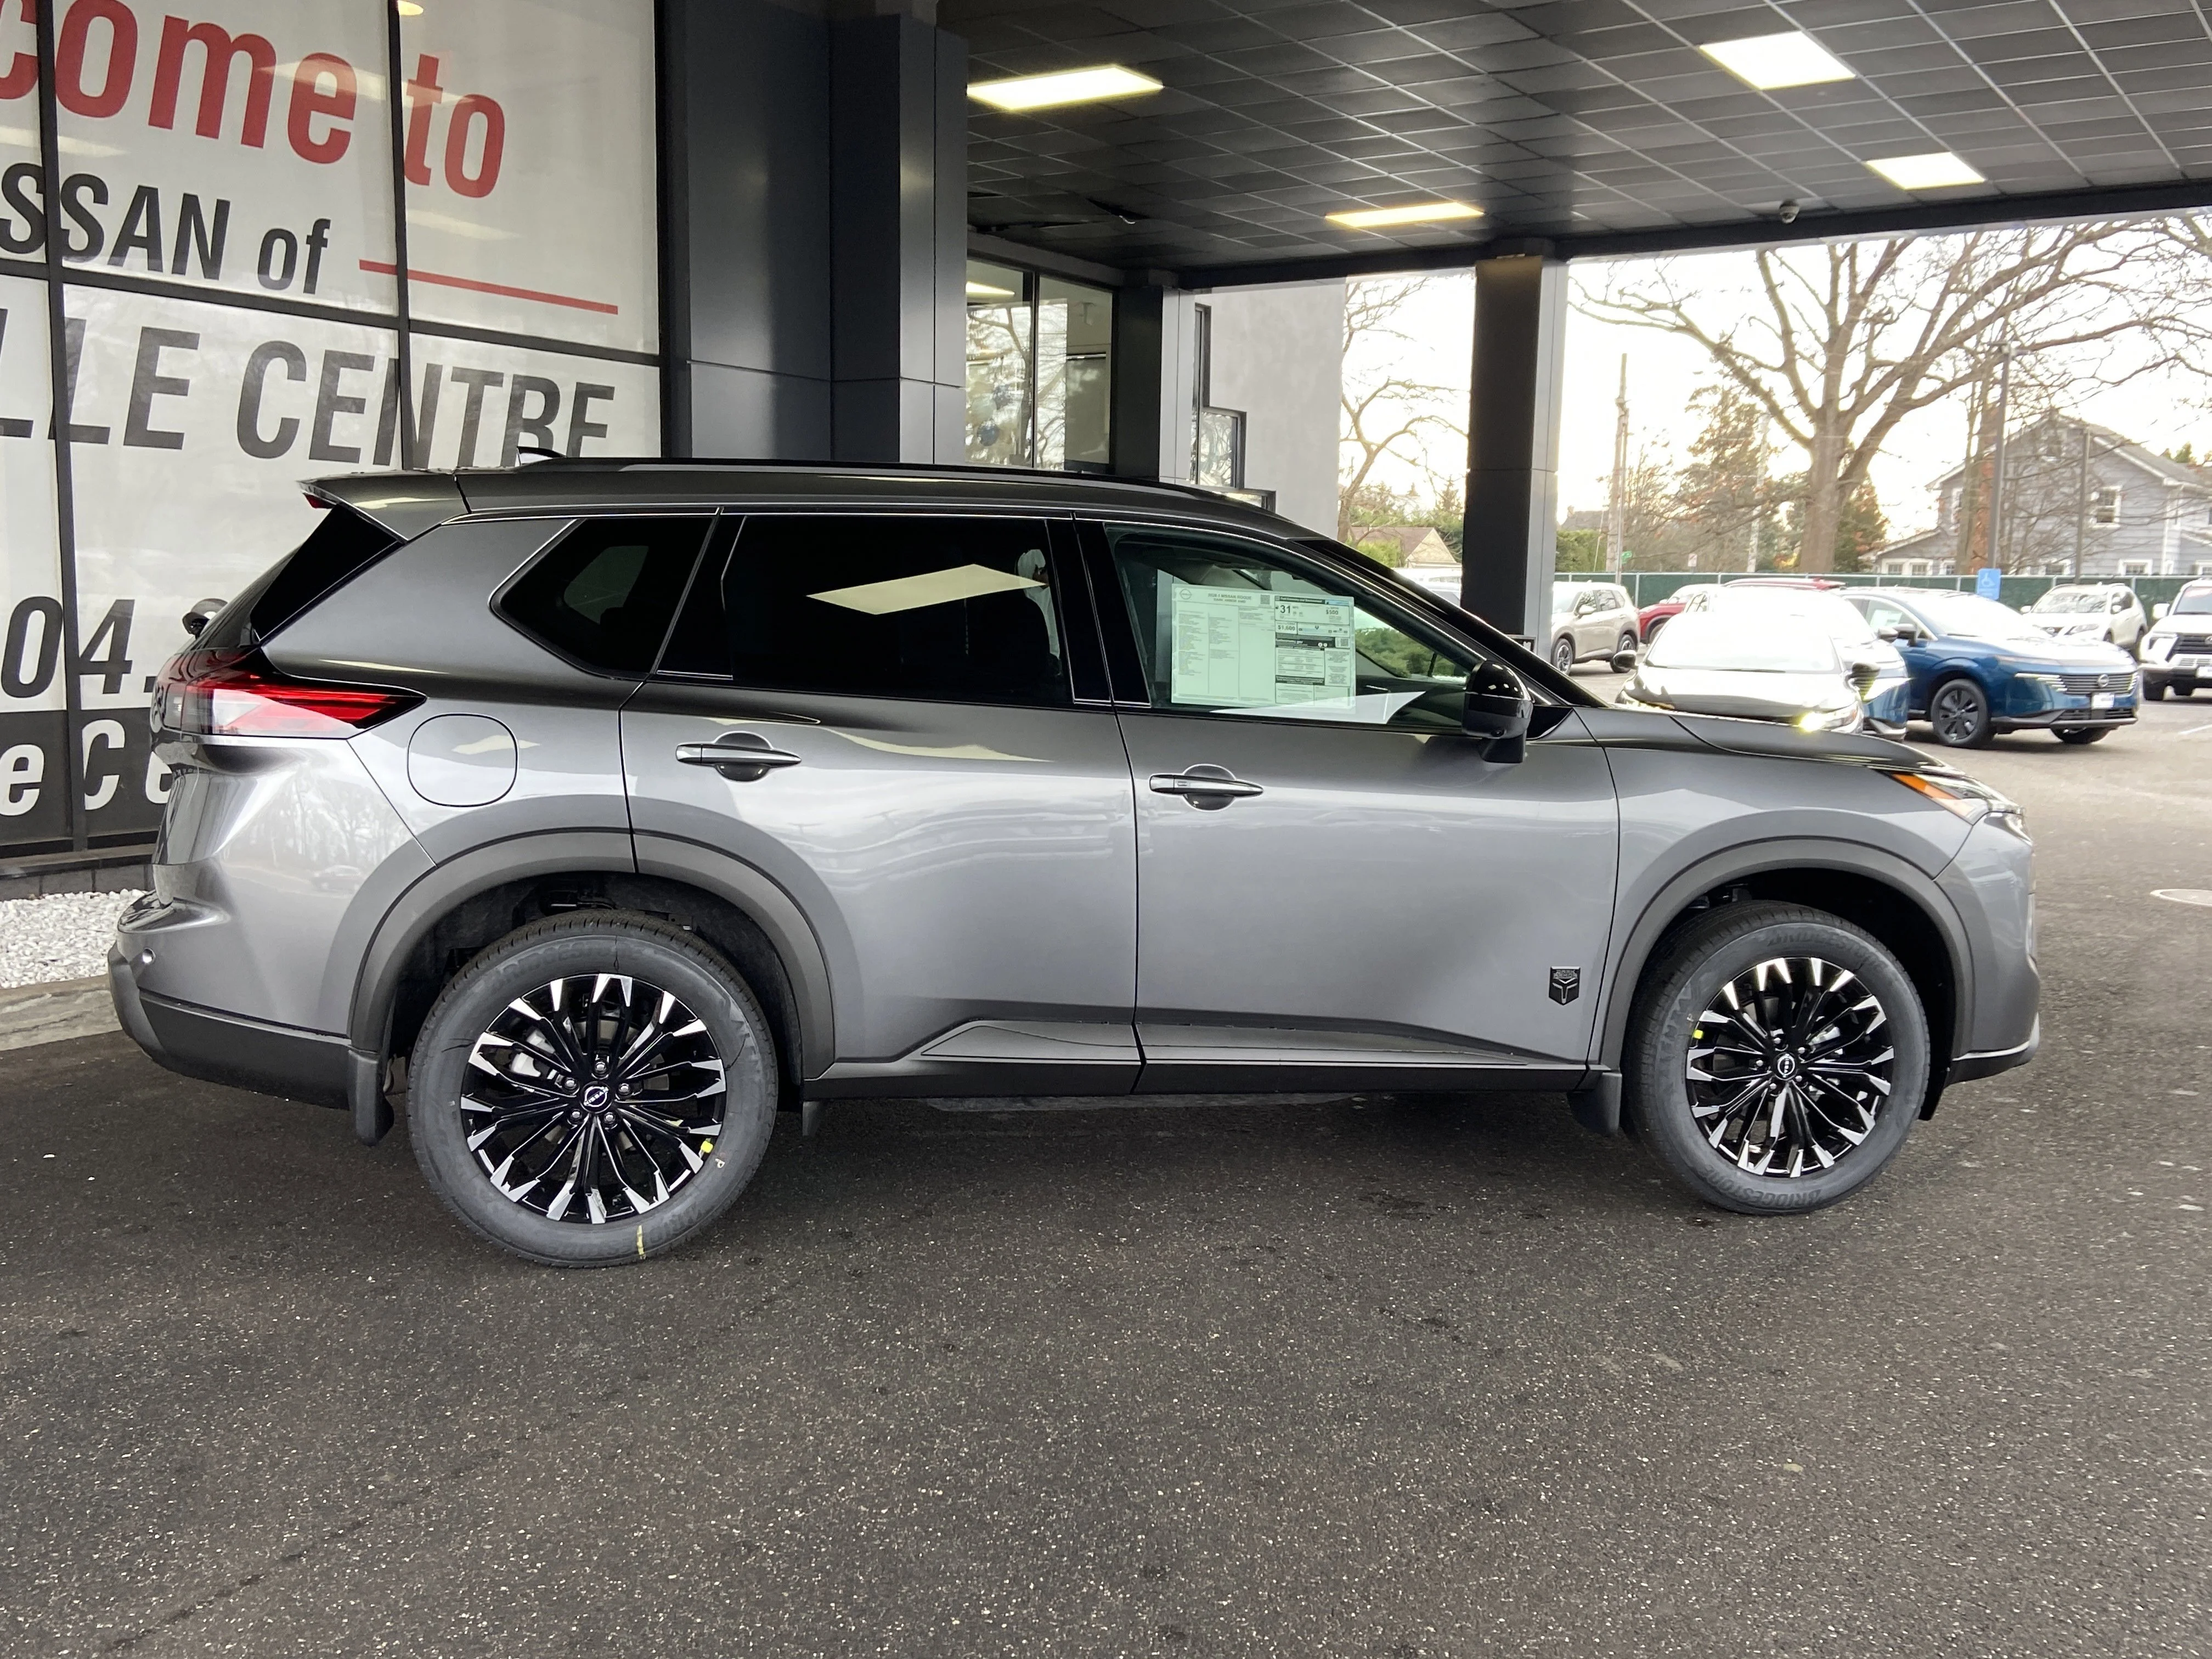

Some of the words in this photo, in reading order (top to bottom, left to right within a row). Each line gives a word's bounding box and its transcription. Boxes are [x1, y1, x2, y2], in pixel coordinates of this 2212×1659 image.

[404, 53, 505, 198] to
[0, 163, 230, 280] SSAN
[257, 218, 331, 295] of
[237, 340, 616, 469] CENTRE
[1280, 605, 1290, 613] 31
[0, 744, 44, 816] e
